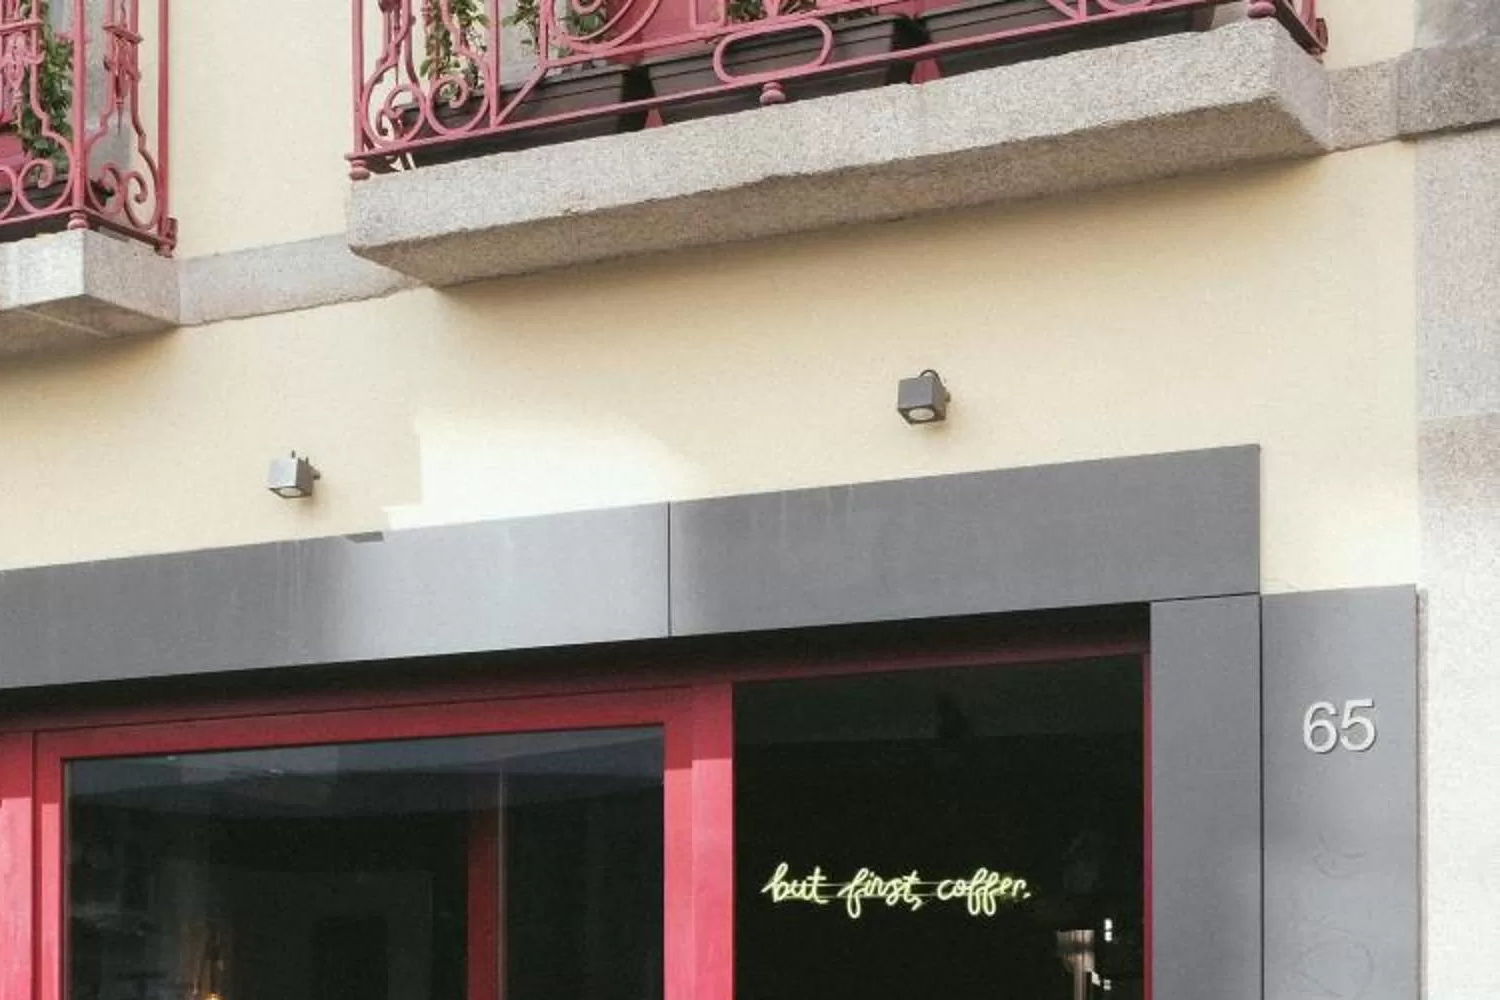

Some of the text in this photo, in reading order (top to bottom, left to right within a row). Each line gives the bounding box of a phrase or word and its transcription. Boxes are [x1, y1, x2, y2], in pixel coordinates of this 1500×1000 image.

[1303, 698, 1376, 754] 65
[761, 861, 829, 903] but
[836, 867, 925, 919] first,
